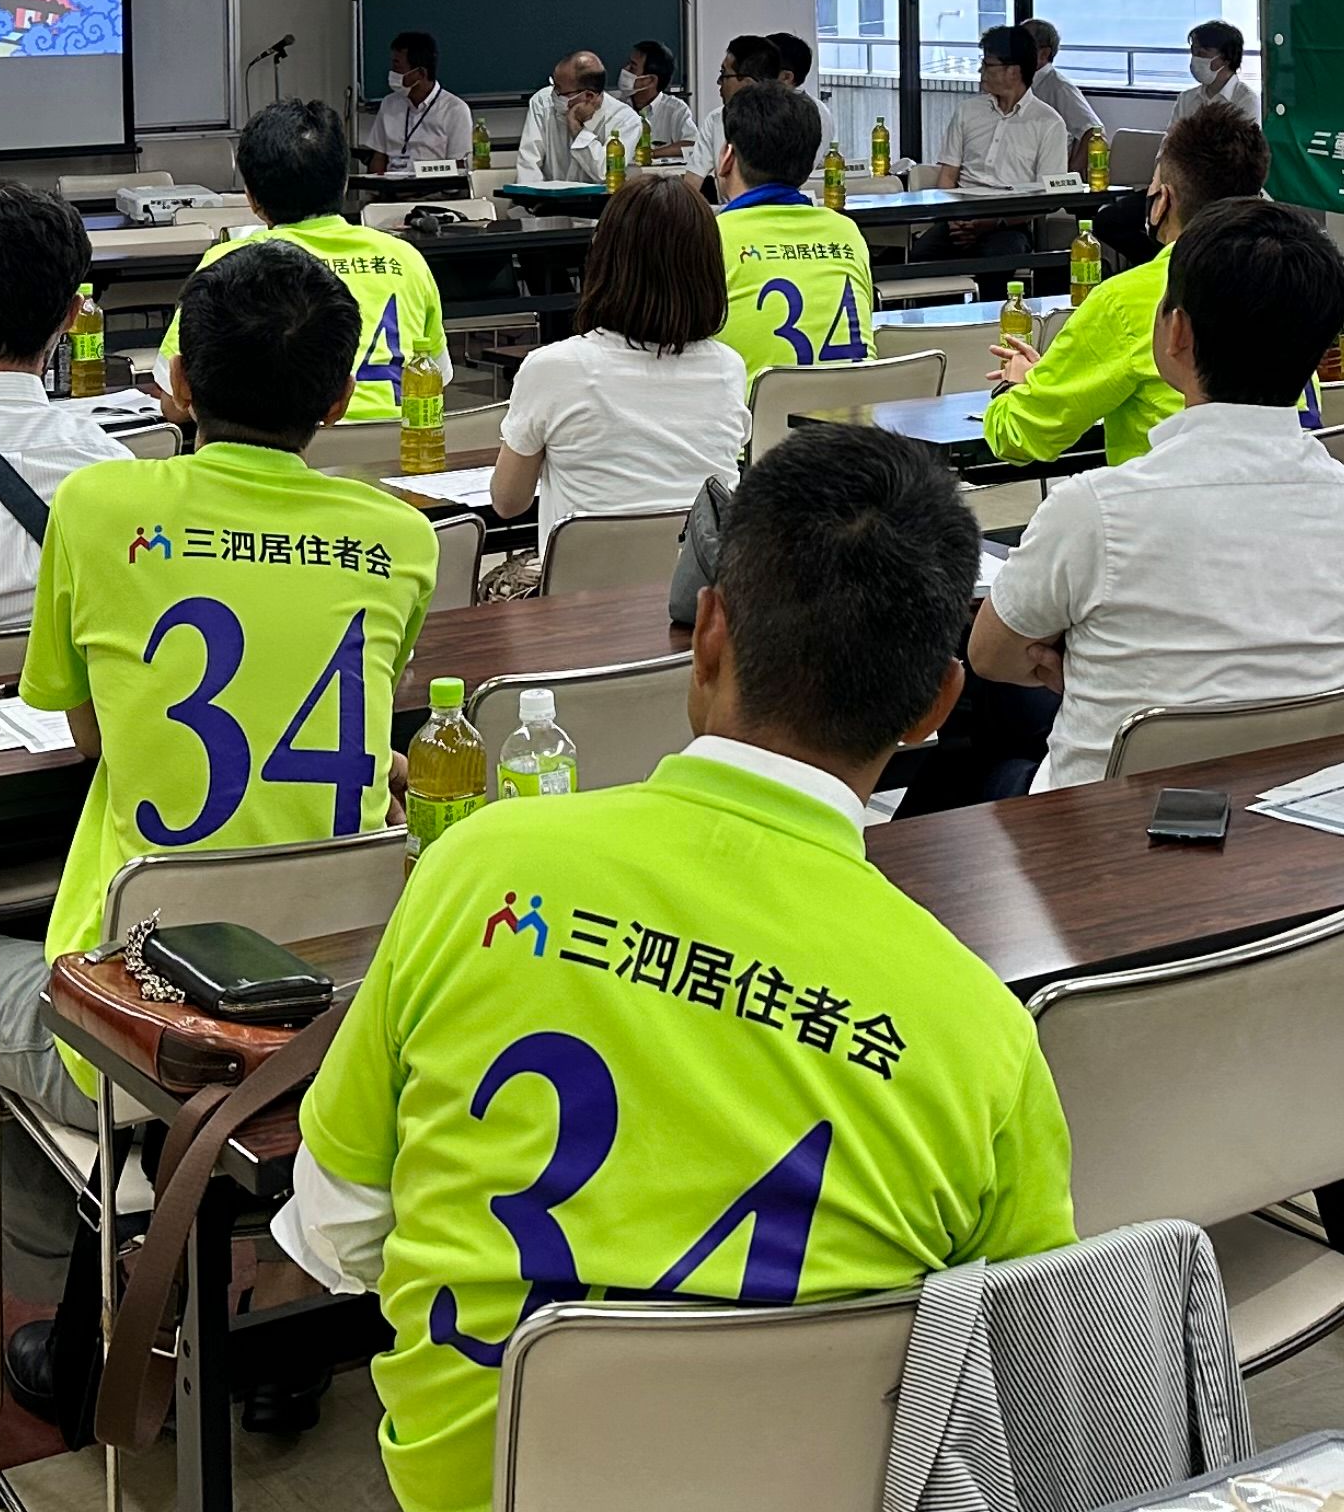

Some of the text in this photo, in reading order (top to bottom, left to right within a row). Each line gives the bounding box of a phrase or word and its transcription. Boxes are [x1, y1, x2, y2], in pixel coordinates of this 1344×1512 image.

[320, 256, 403, 276] 居住者会
[764, 242, 855, 260] 三泗居住者会
[356, 293, 405, 407] 4
[756, 273, 869, 366] 34
[182, 524, 393, 580] 三泗居住者会
[135, 596, 377, 846] 34
[559, 908, 907, 1081] 三泗居住者会
[428, 1031, 834, 1368] 34
